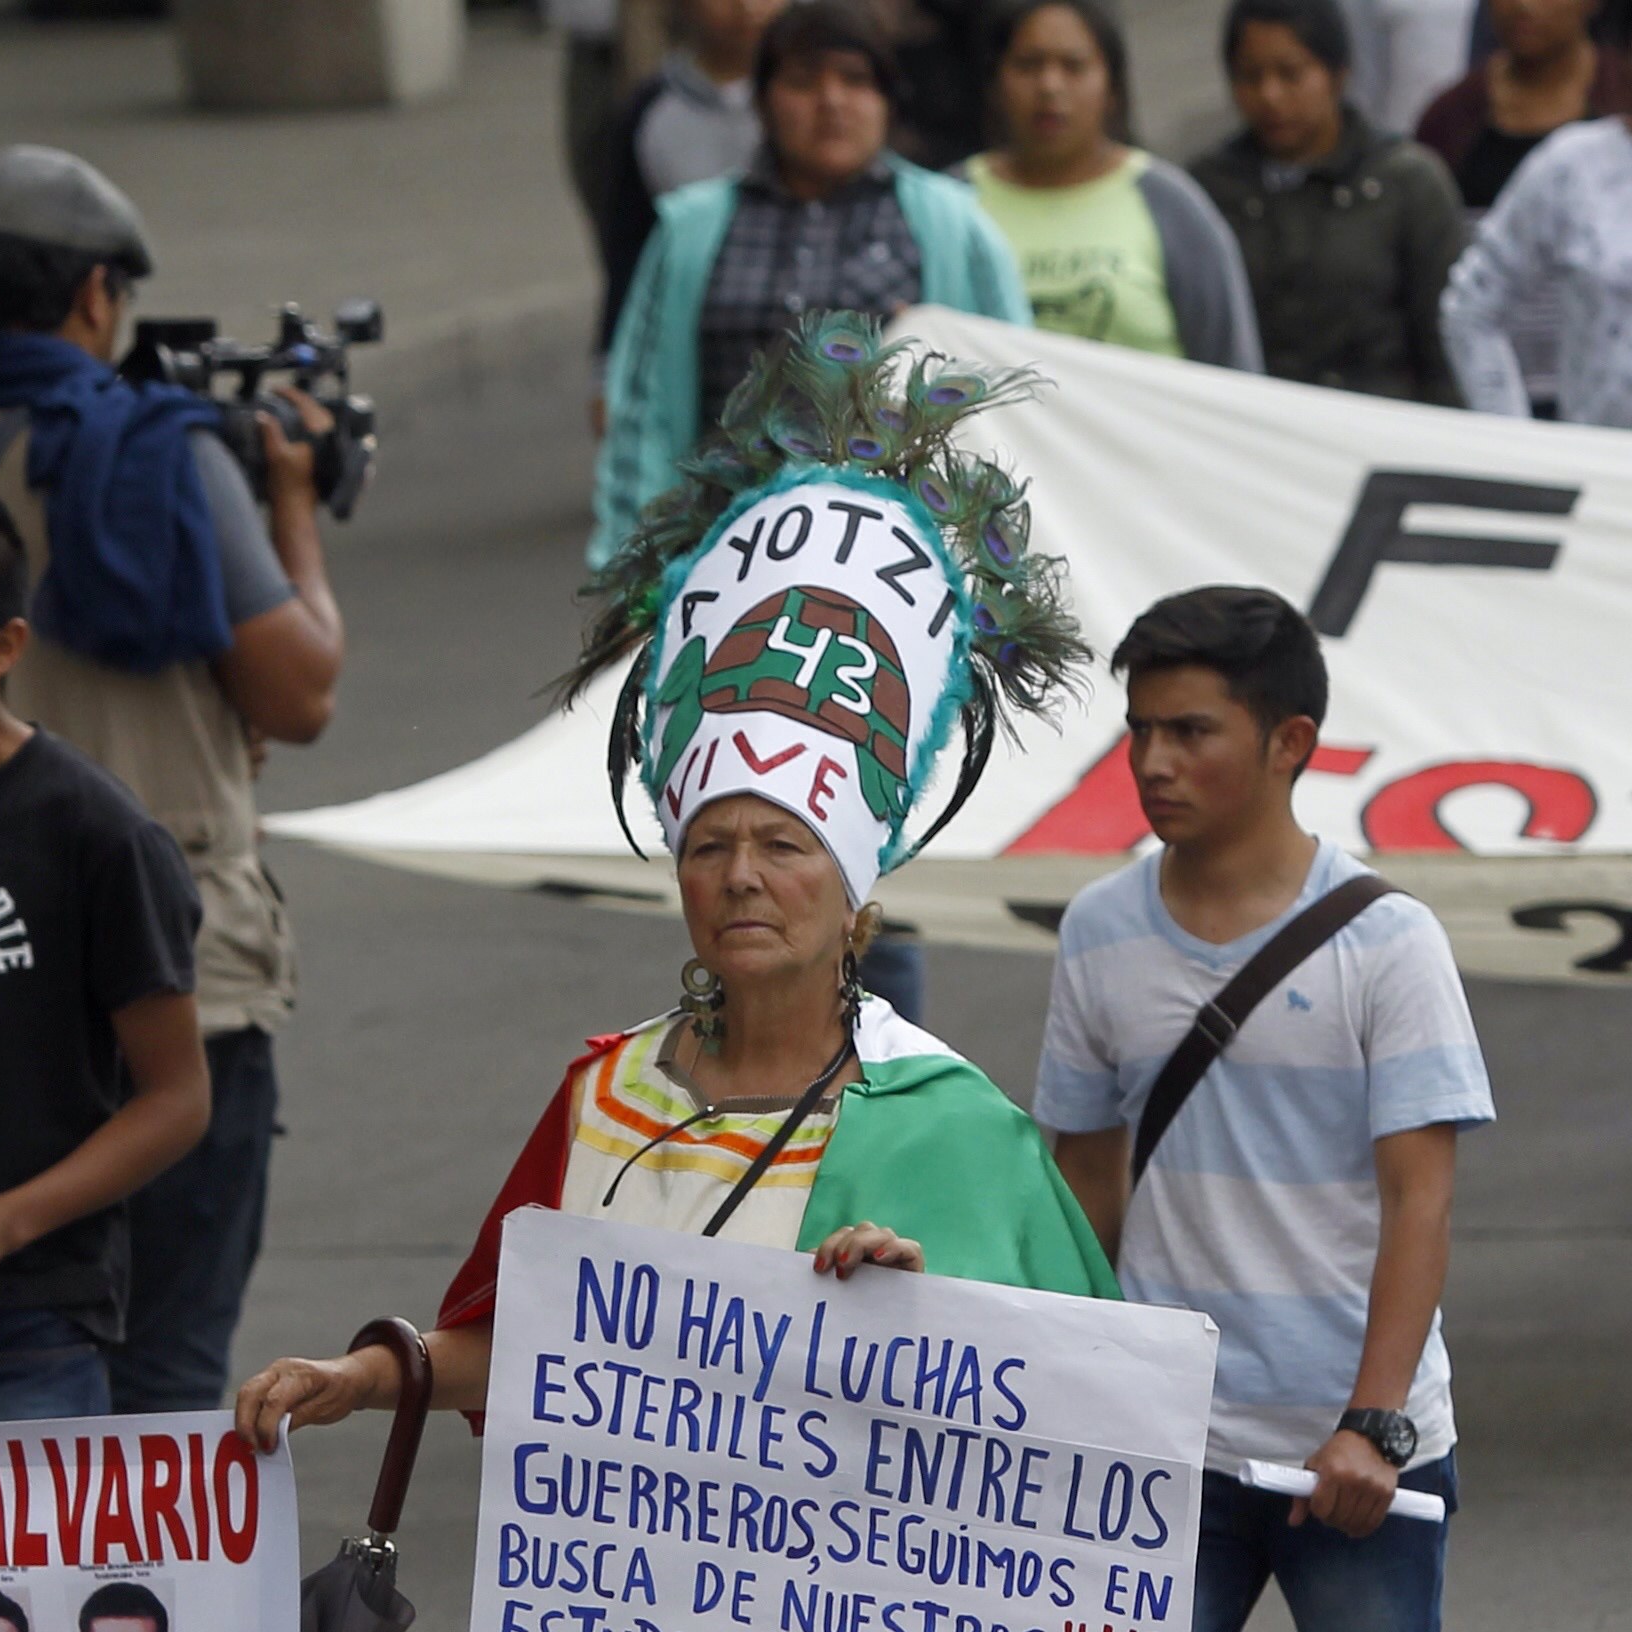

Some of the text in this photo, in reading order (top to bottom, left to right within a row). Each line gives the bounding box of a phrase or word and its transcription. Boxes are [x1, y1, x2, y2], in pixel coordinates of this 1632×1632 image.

[766, 615, 879, 716] 43
[666, 729, 848, 822] VIVE
[573, 1255, 1028, 1432] NO HAY LUCHAS
[532, 1353, 1172, 1551] ESTERILES ENTRE LOS
[498, 1521, 658, 1607] BUSCA
[692, 1560, 755, 1626] DE
[1104, 1563, 1174, 1622] EN
